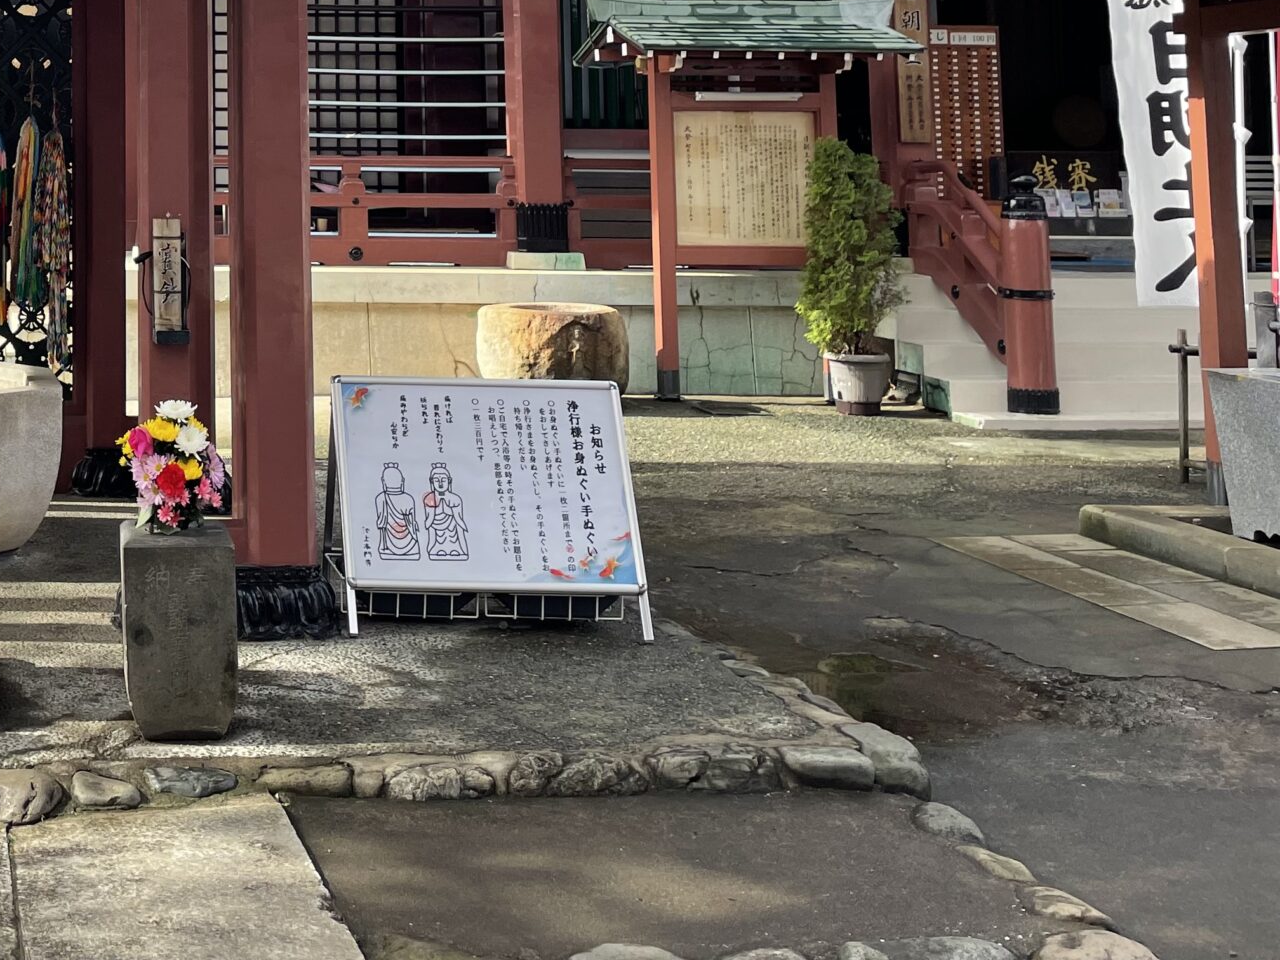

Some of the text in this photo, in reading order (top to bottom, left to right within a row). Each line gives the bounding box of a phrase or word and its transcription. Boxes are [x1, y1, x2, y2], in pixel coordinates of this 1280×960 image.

[513, 407, 527, 470] 持ち帰りください
[589, 423, 607, 475] お知らせ
[566, 399, 599, 557] 浄行様お身ぬぐい手ぬぐい
